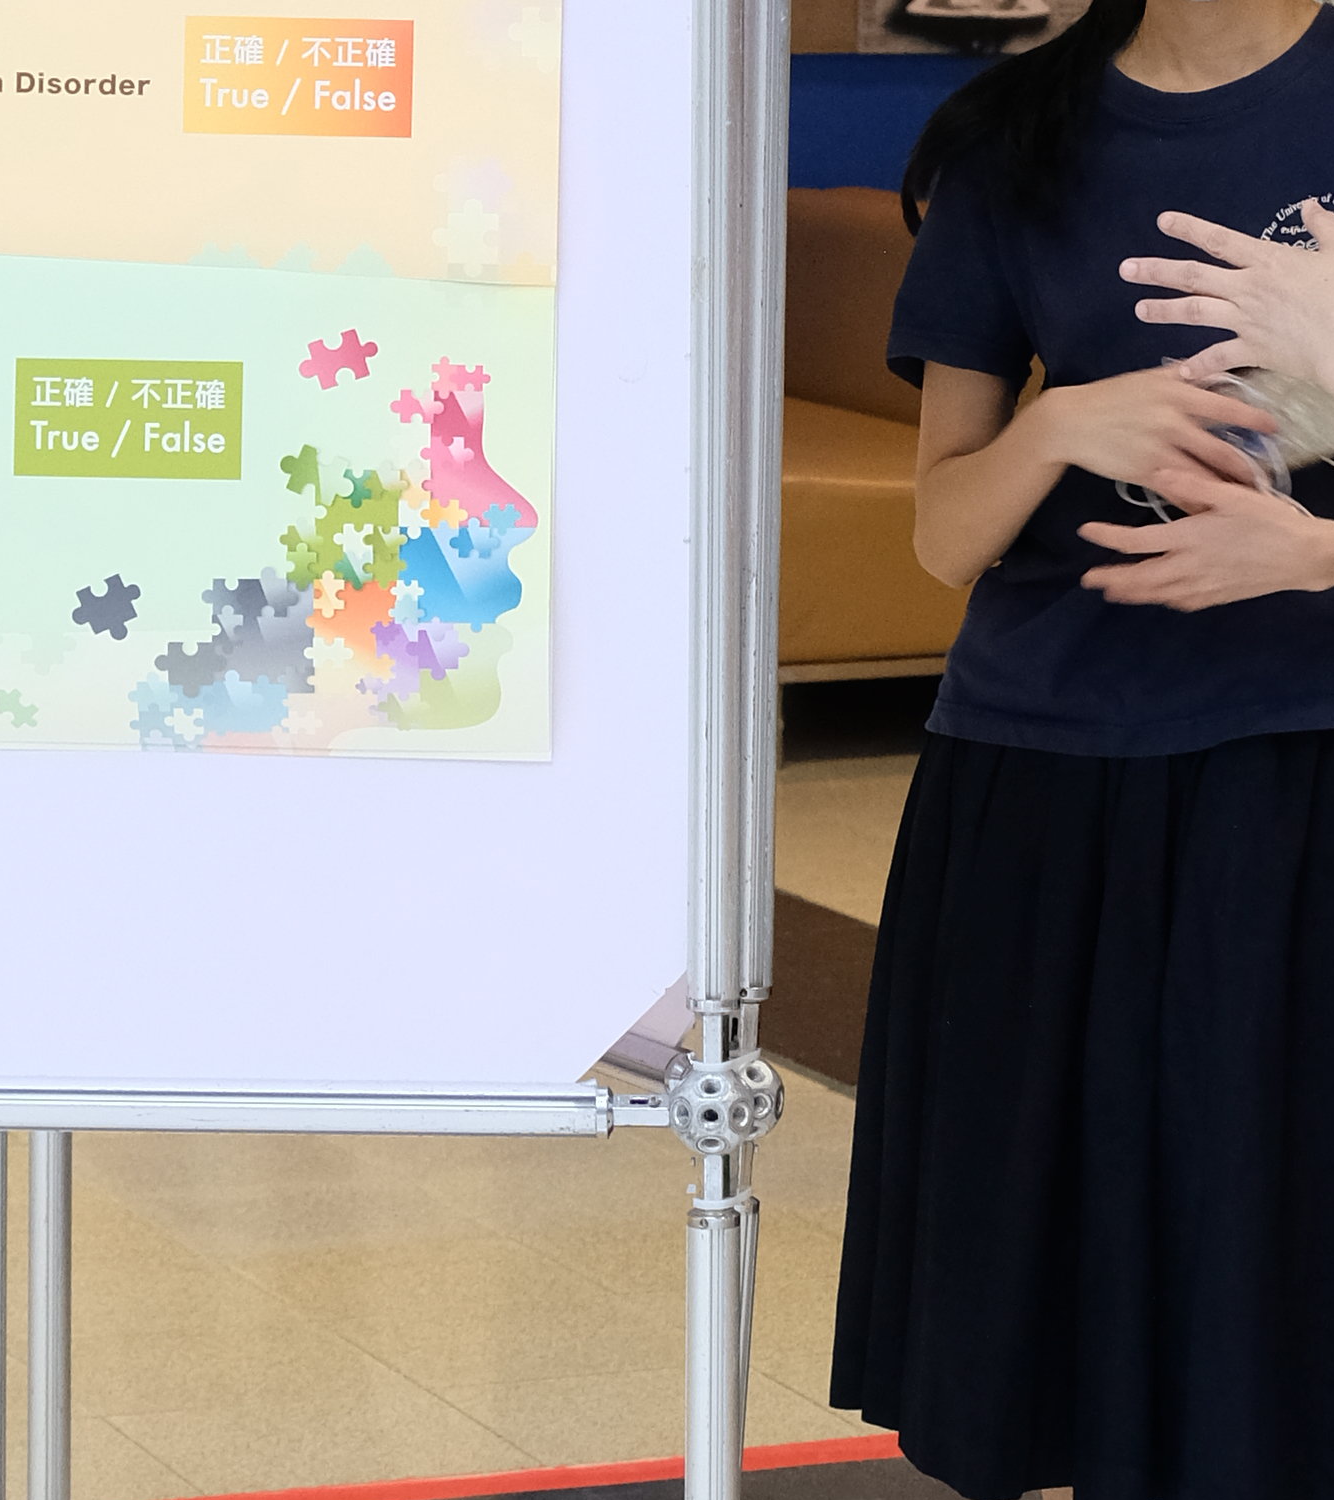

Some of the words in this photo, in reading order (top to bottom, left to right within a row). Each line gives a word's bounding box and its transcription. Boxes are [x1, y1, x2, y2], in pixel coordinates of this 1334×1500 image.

[200, 35, 264, 65] 正確
[276, 40, 289, 65] /
[301, 37, 396, 68] 不正確
[16, 71, 151, 96] Disorder
[200, 78, 268, 109] True
[281, 78, 302, 115] /
[314, 80, 396, 111] False
[31, 377, 93, 407] 正確
[105, 381, 118, 407] /
[131, 379, 226, 410] 不正確
[30, 420, 100, 451] True
[111, 420, 131, 457] /
[144, 421, 226, 454] False
